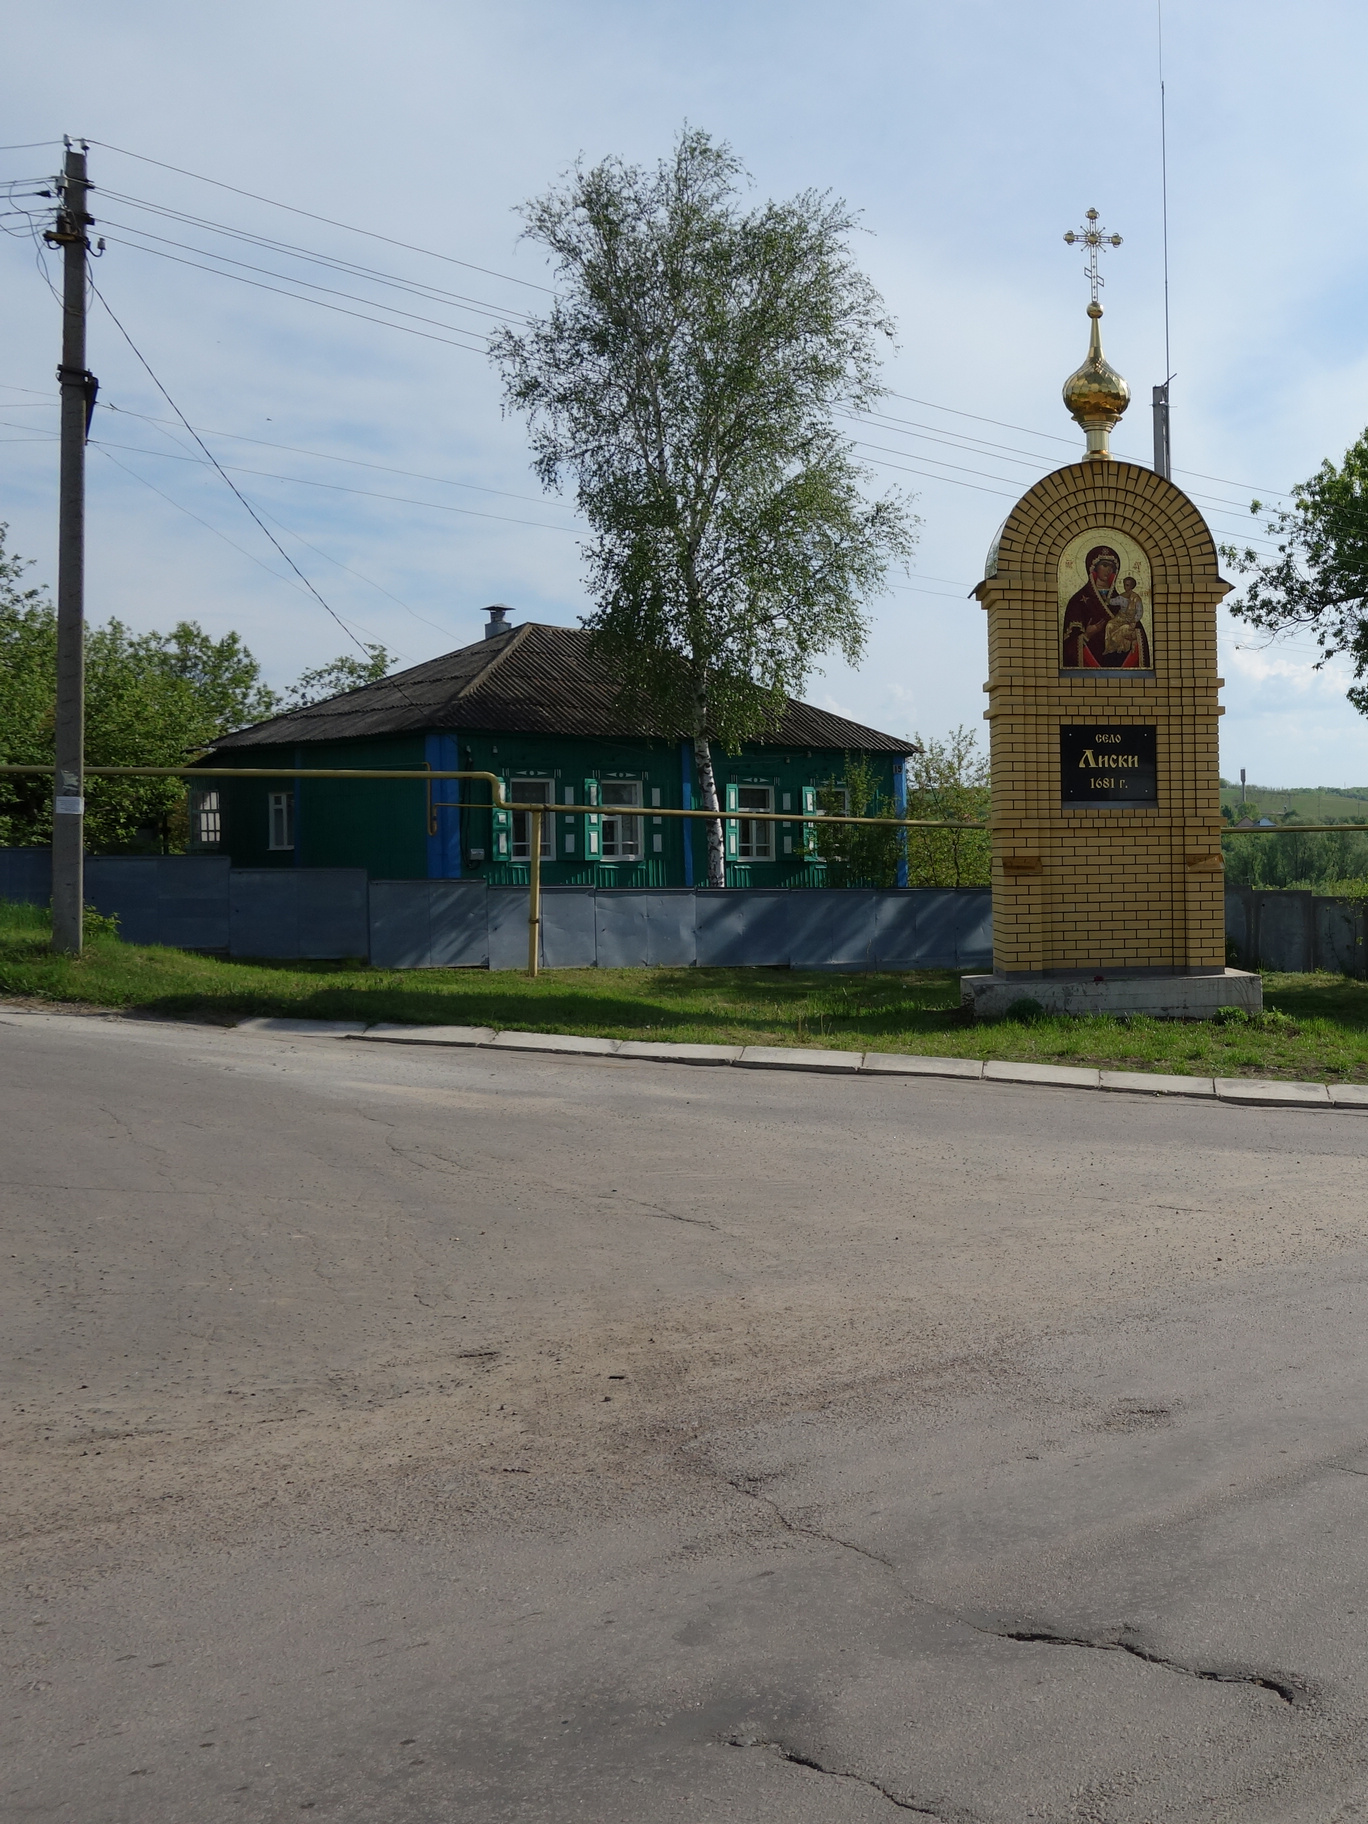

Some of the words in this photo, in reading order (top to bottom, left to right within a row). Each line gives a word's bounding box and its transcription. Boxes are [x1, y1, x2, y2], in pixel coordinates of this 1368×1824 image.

[1079, 749, 1138, 768] Лиски
[894, 765, 902, 773] 15
[1090, 777, 1115, 789] 1681
[1119, 779, 1128, 789] г.
